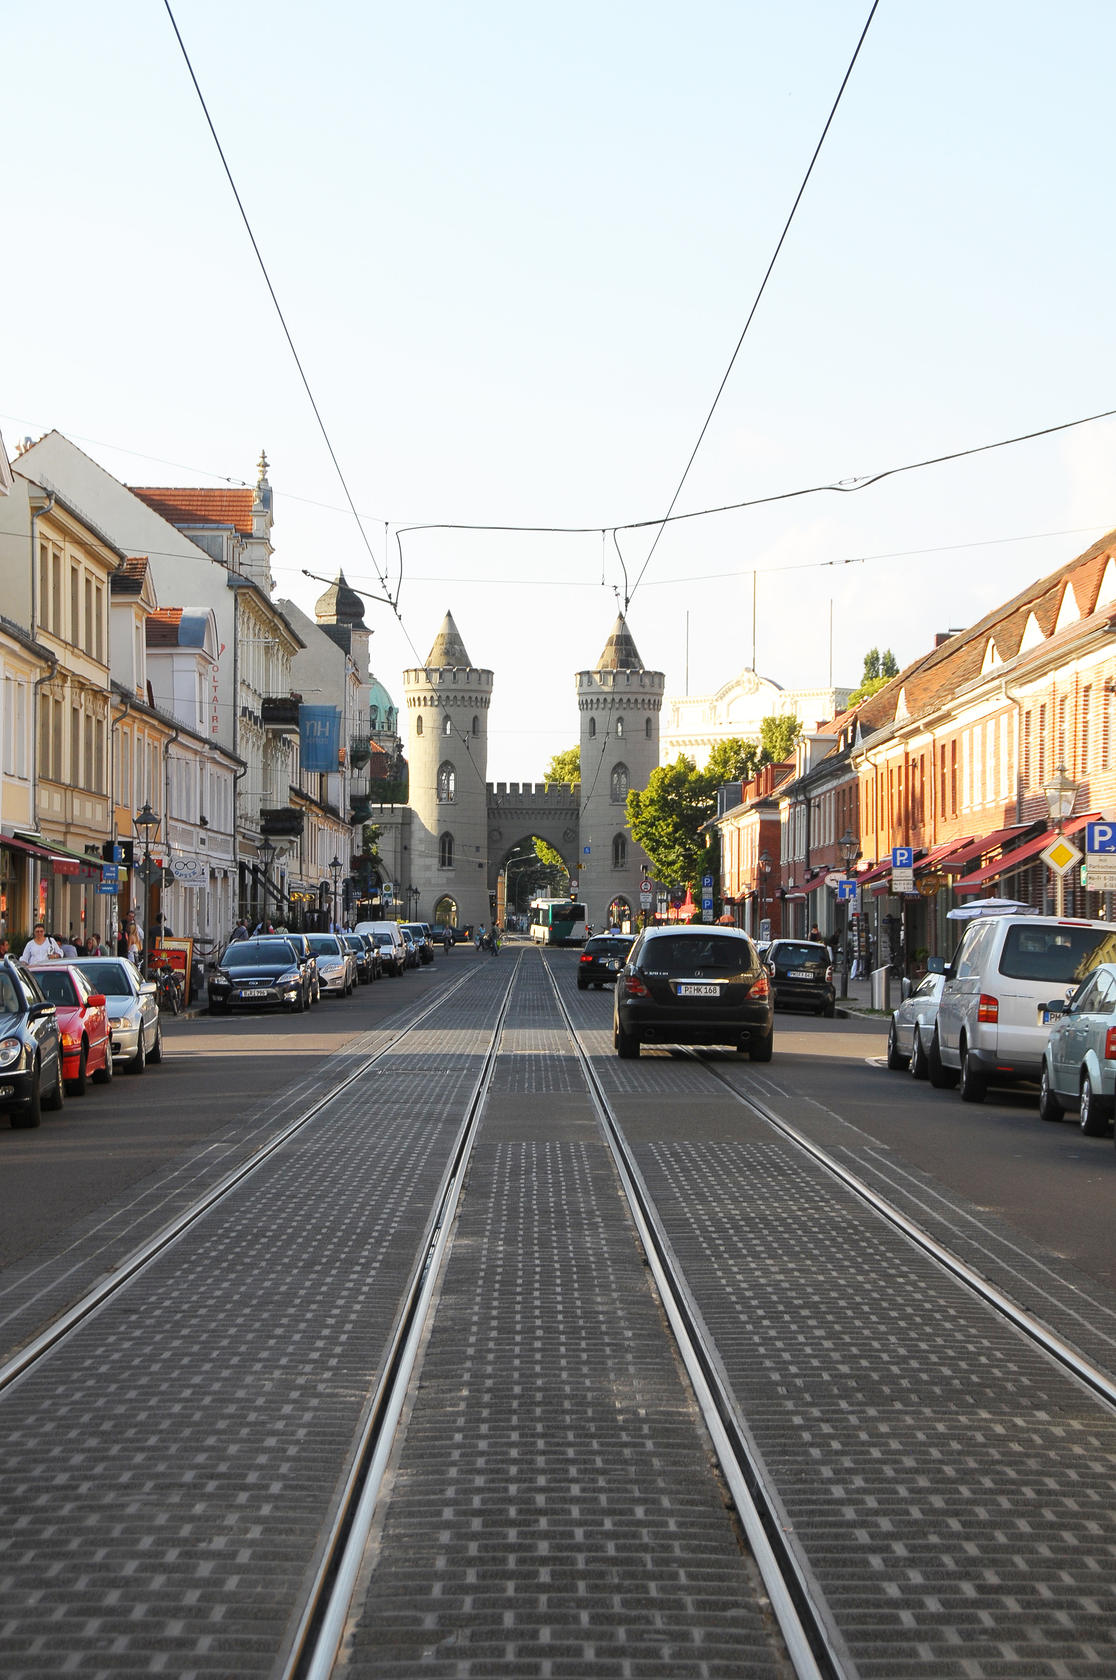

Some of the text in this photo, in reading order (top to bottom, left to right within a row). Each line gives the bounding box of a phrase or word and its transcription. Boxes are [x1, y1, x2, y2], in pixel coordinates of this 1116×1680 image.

[1094, 825, 1113, 851] P
[896, 849, 909, 866] P
[704, 877, 711, 886] P
[704, 900, 711, 909] P
